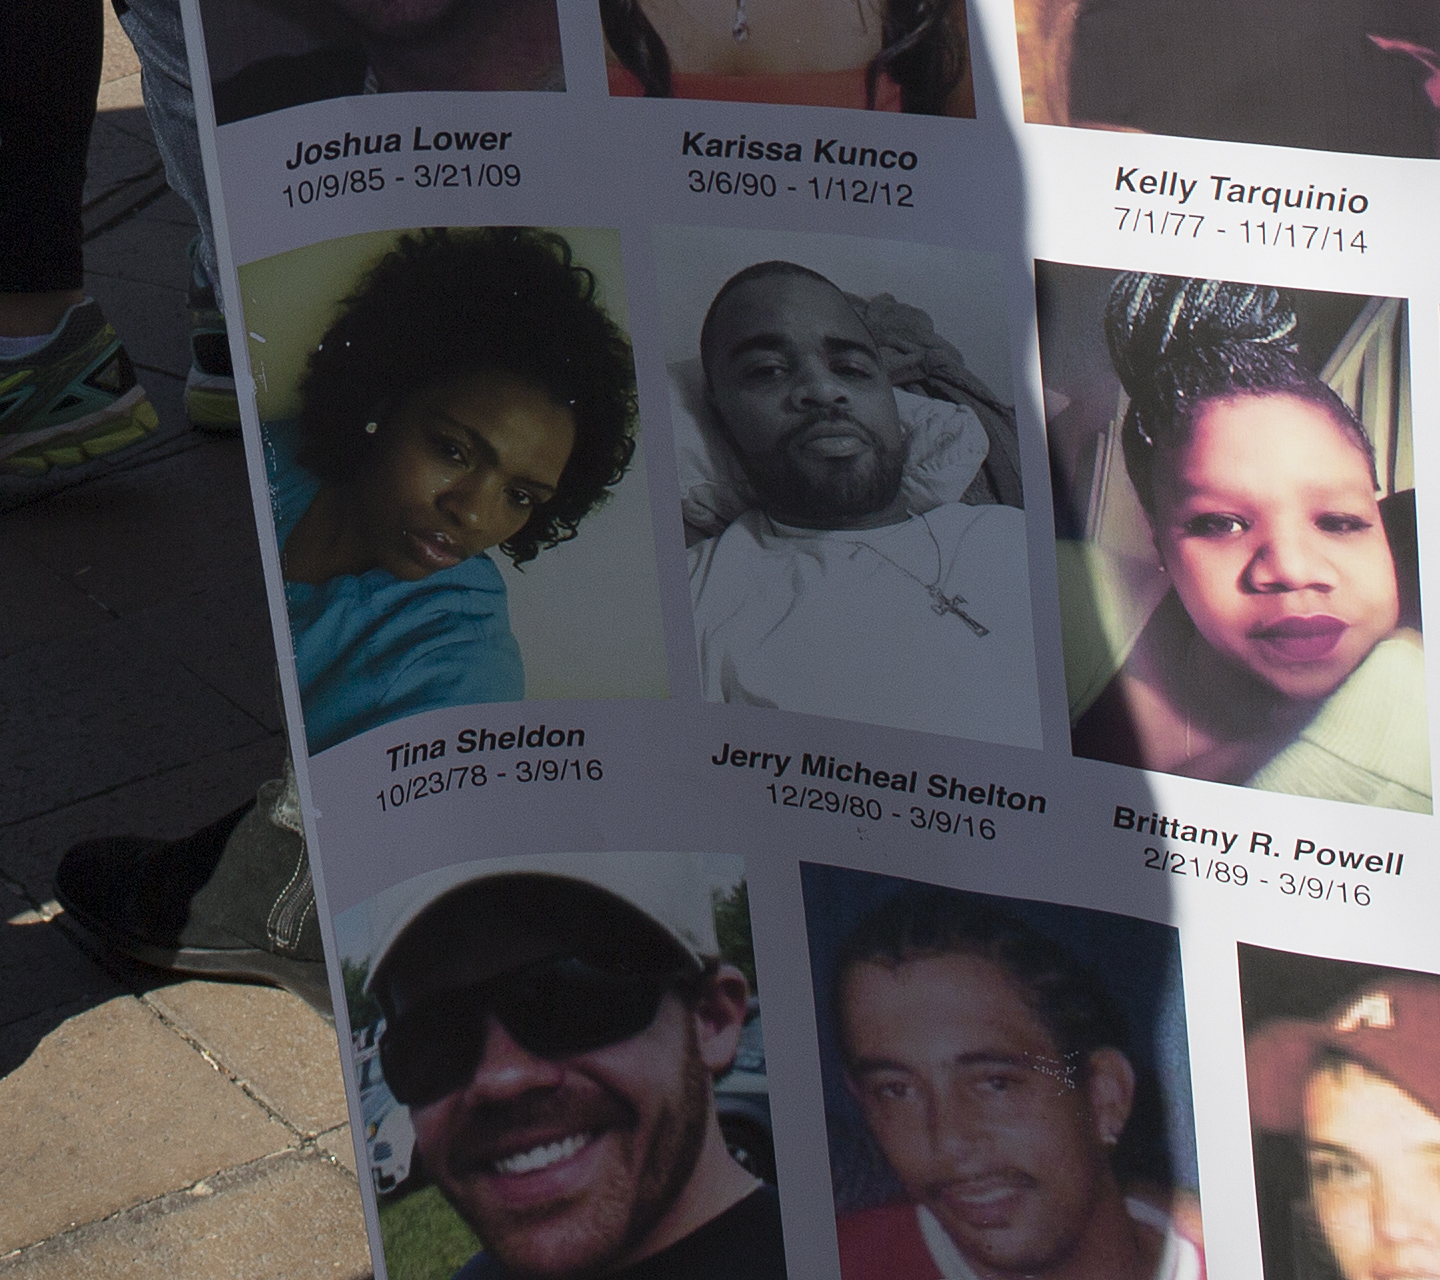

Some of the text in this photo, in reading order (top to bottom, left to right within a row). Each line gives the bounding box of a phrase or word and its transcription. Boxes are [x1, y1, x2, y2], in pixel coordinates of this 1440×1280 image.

[285, 126, 513, 171] Joshua Lower
[682, 131, 918, 171] Karissa Kunco
[282, 167, 385, 208] 10/9/85
[414, 163, 521, 188] 3/21/09
[688, 169, 777, 198] 3/6/90
[808, 176, 914, 208] 1/12/12
[1115, 166, 1369, 214] Kelly Tarquinio
[1114, 207, 1205, 238] 7/1/77
[1240, 220, 1367, 254] 11/17/14
[386, 724, 585, 773] Tina Sheldon
[376, 764, 488, 812] 10/23/78
[515, 758, 604, 783] 3/9/16
[711, 742, 1047, 814] Jerry Micheal Shelton
[766, 783, 883, 821] 12/29/80
[909, 806, 996, 841] 3/9/16
[1113, 805, 1404, 876] Brittany R. Powell
[1143, 847, 1249, 886] 2/21/89
[1279, 873, 1371, 906] 3/9/16
